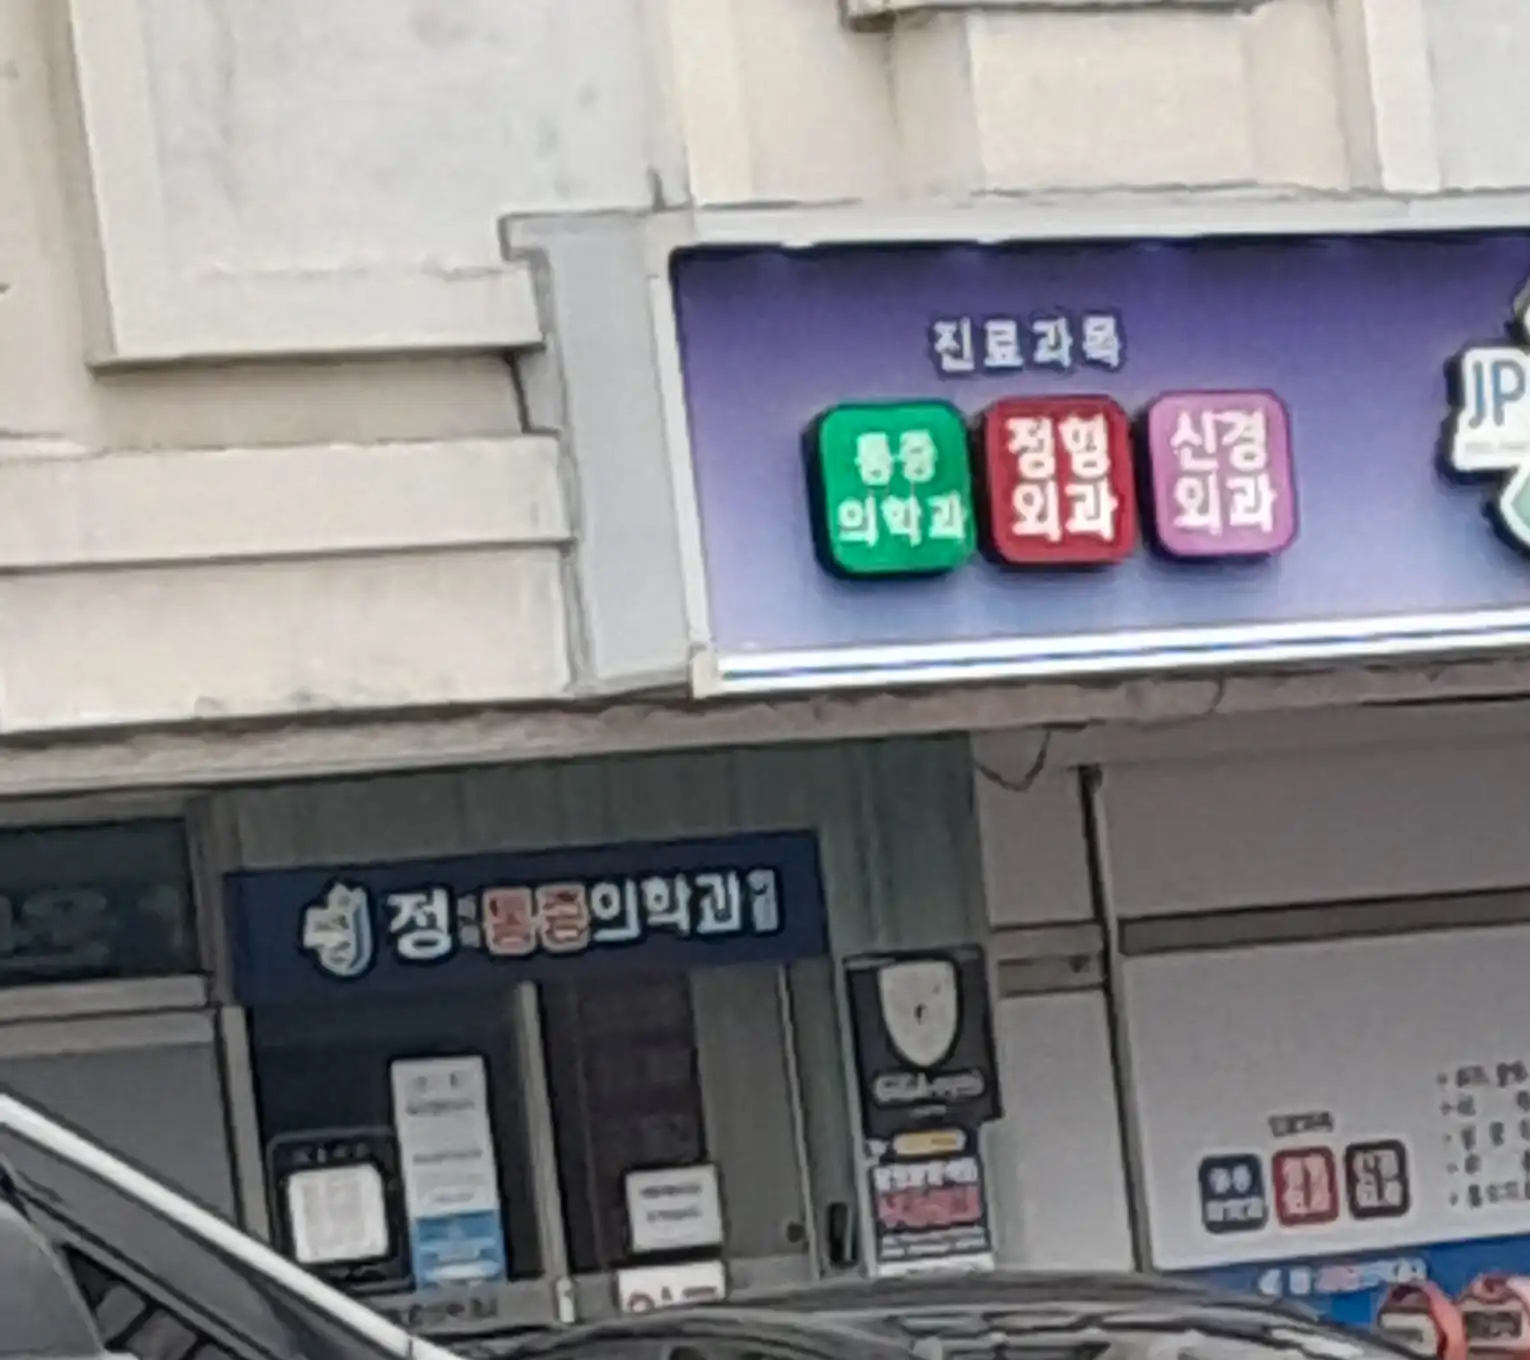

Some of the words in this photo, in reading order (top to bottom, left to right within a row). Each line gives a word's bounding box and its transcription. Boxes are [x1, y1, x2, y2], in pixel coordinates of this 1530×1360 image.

[933, 313, 1122, 373] 진료과목
[854, 428, 940, 486] 통증
[1004, 412, 1112, 480] 정형
[1170, 408, 1268, 474] 신경
[836, 488, 970, 548] 의학과
[1010, 478, 1119, 543] 외과
[1172, 470, 1279, 536] 외과
[387, 886, 452, 960] 정
